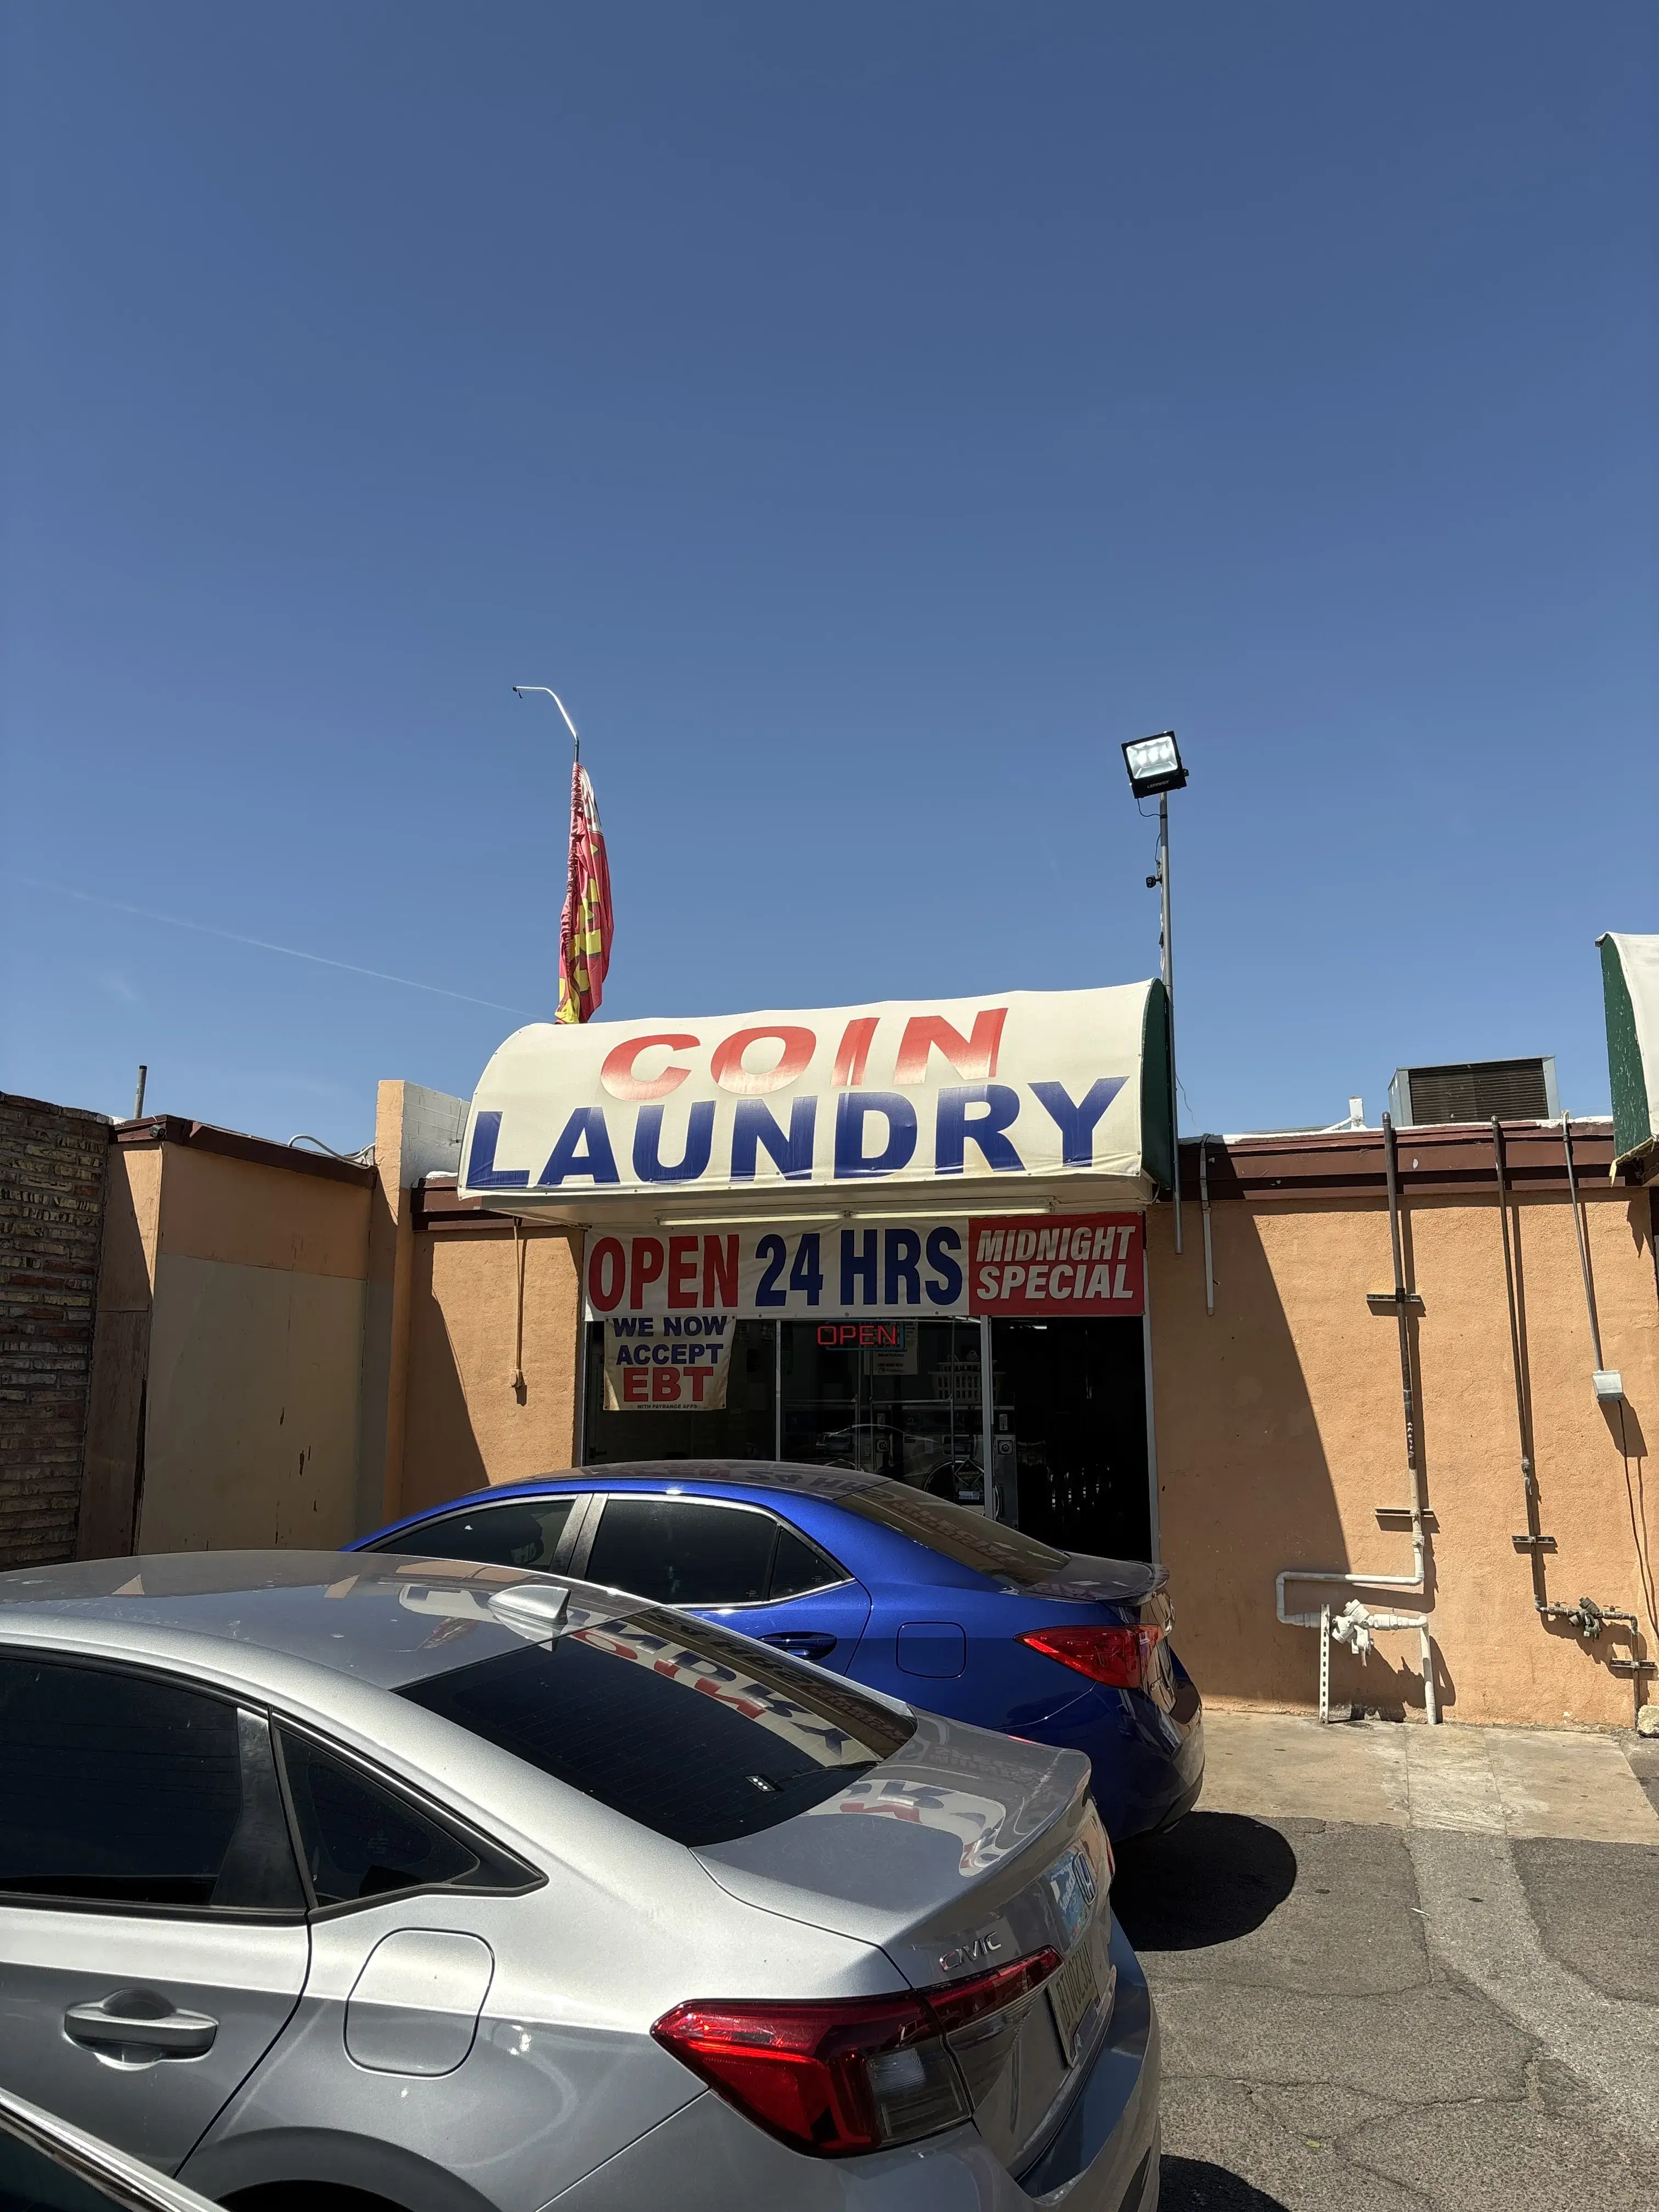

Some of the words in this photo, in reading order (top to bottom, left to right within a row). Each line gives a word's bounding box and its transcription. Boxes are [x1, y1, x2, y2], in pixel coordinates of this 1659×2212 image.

[601, 1007, 1009, 1101] COIN
[466, 1076, 1130, 1189] LAUNDRY
[976, 1226, 1137, 1262] MIDNIGHT
[588, 1234, 740, 1311] OPEN
[755, 1233, 823, 1307] 24
[840, 1226, 963, 1306] HRS
[977, 1264, 1134, 1300] SPECIAL
[612, 1317, 654, 1338] WE
[664, 1315, 727, 1337] NOW
[816, 1324, 898, 1346] OPEN
[616, 1343, 724, 1365] ACCEPT
[623, 1366, 714, 1402] EBT
[939, 1931, 1002, 1972] CIVIC
